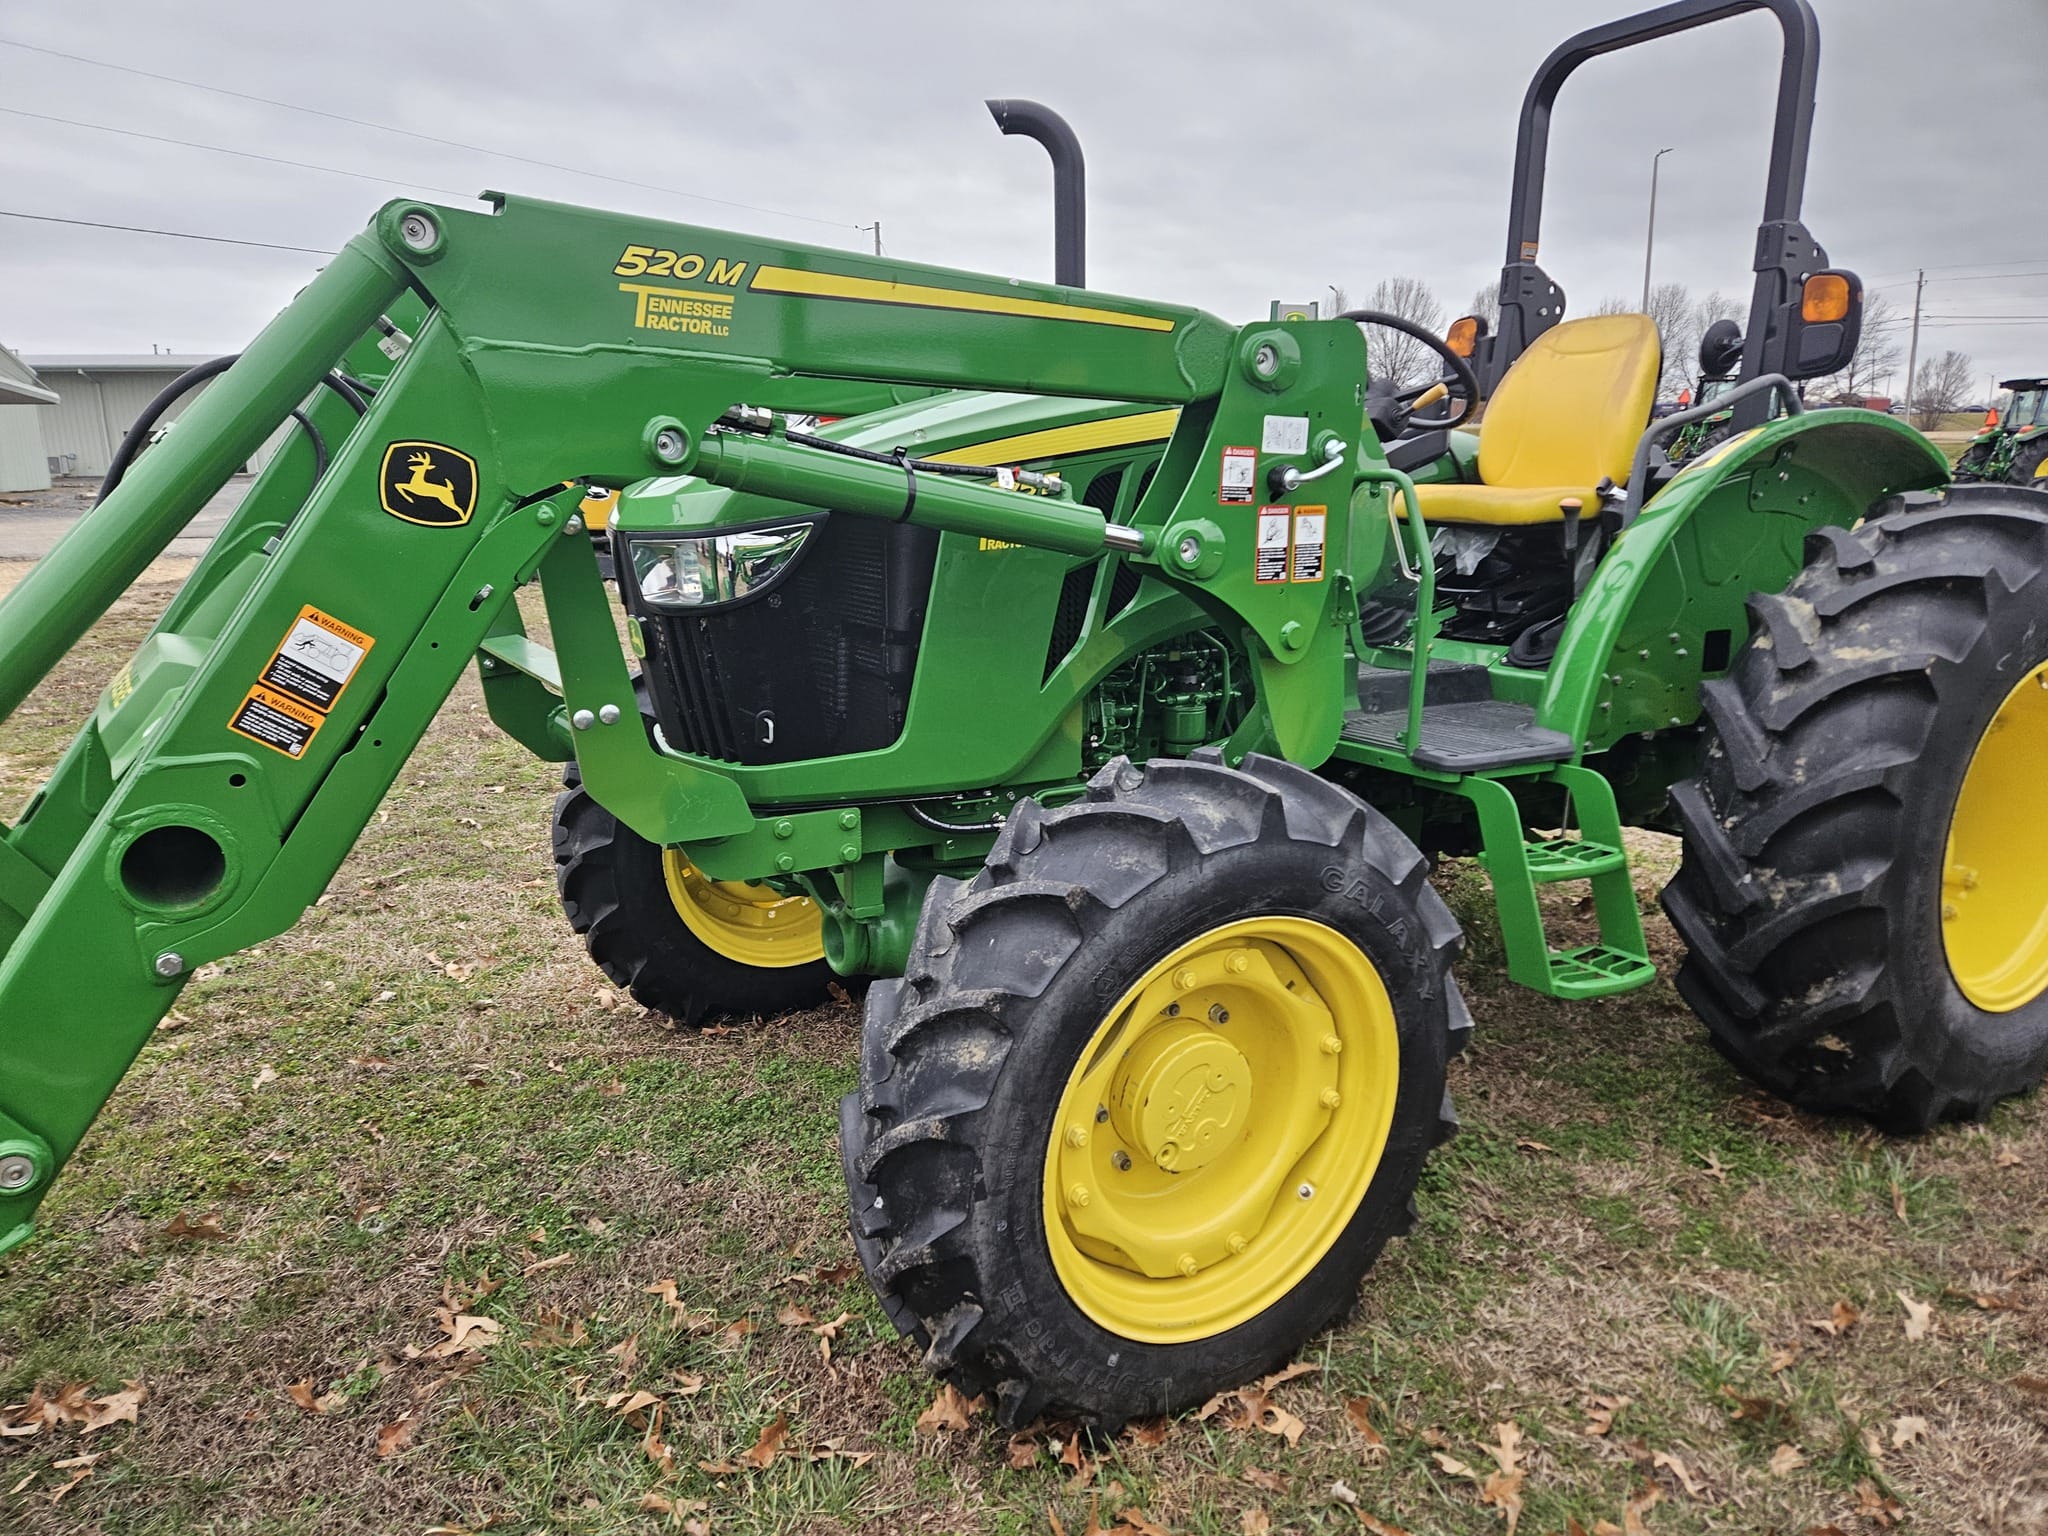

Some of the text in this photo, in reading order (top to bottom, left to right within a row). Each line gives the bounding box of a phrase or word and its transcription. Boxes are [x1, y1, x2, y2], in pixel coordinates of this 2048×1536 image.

[712, 324, 729, 336] LLC
[321, 616, 364, 645] WARNING
[270, 697, 315, 723] WARNING
[1321, 865, 1436, 1000] GALAXY
